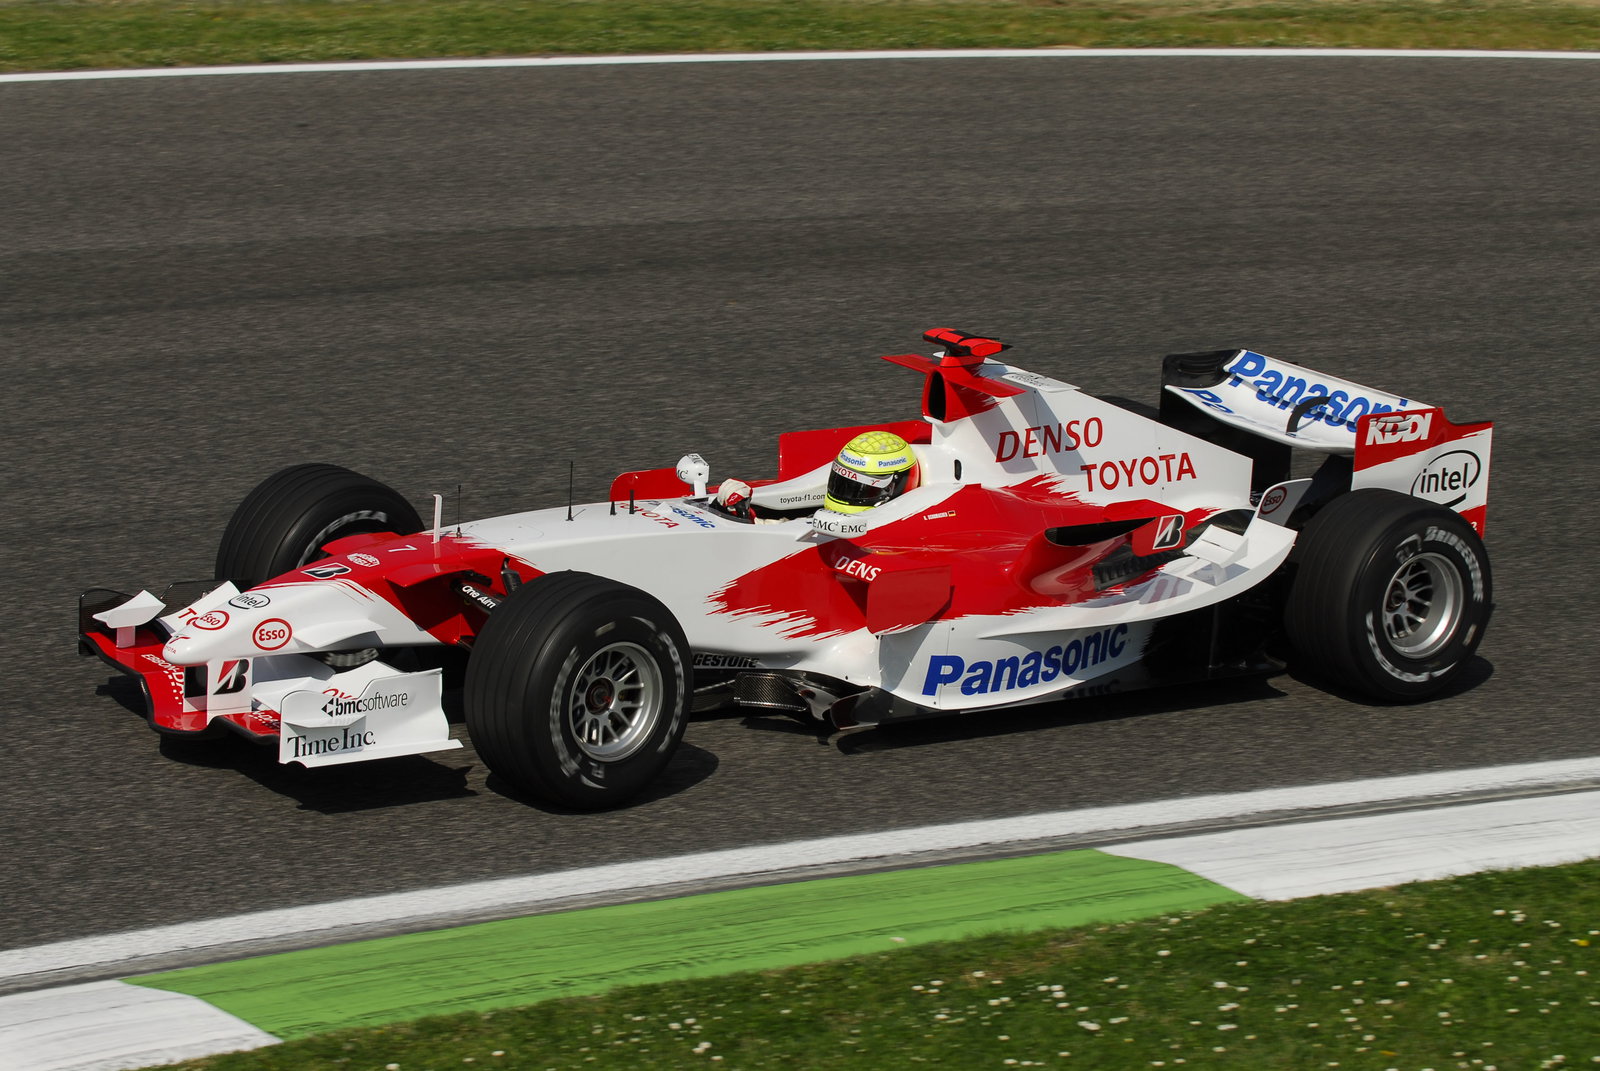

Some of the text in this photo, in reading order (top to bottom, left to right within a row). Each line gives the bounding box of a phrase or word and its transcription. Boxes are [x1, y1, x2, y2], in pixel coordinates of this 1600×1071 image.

[1228, 351, 1408, 432] Panaso
[996, 417, 1103, 463] DENSO
[1365, 413, 1433, 445] KDDI
[878, 457, 907, 467] Panasonic
[1080, 452, 1197, 492] TOYOTA
[1420, 463, 1469, 493] intel
[834, 556, 881, 581] DENS
[462, 585, 480, 598] One
[258, 628, 286, 642] Esso
[922, 623, 1128, 696] Panasonic
[287, 727, 376, 758] Time Inc.
